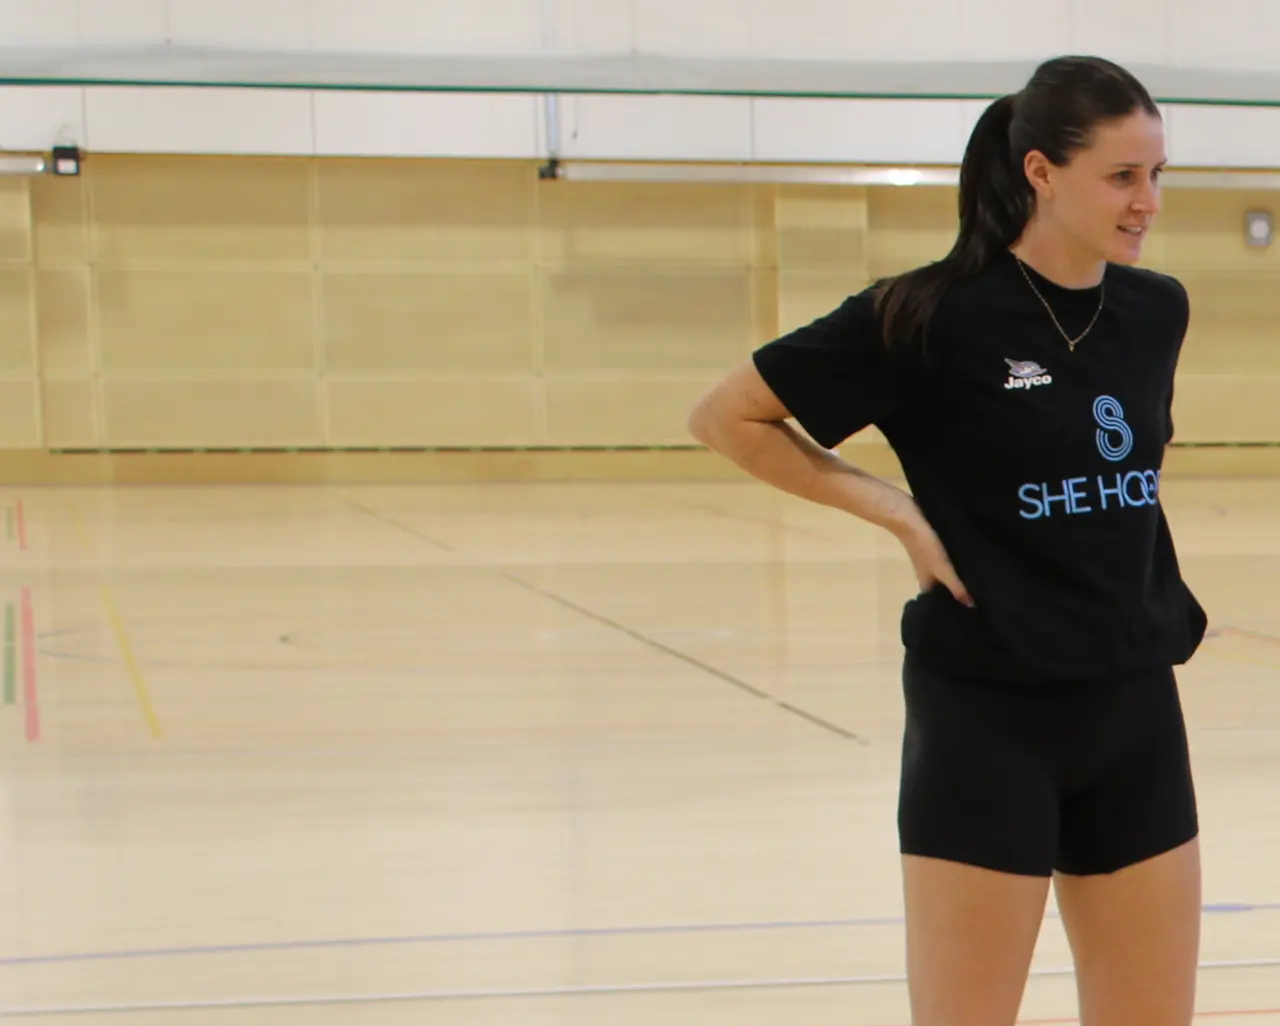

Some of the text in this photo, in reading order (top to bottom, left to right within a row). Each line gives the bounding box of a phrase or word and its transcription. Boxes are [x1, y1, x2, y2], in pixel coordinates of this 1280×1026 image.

[1004, 374, 1052, 390] Jayco
[1019, 469, 1161, 520] SHE HOO
